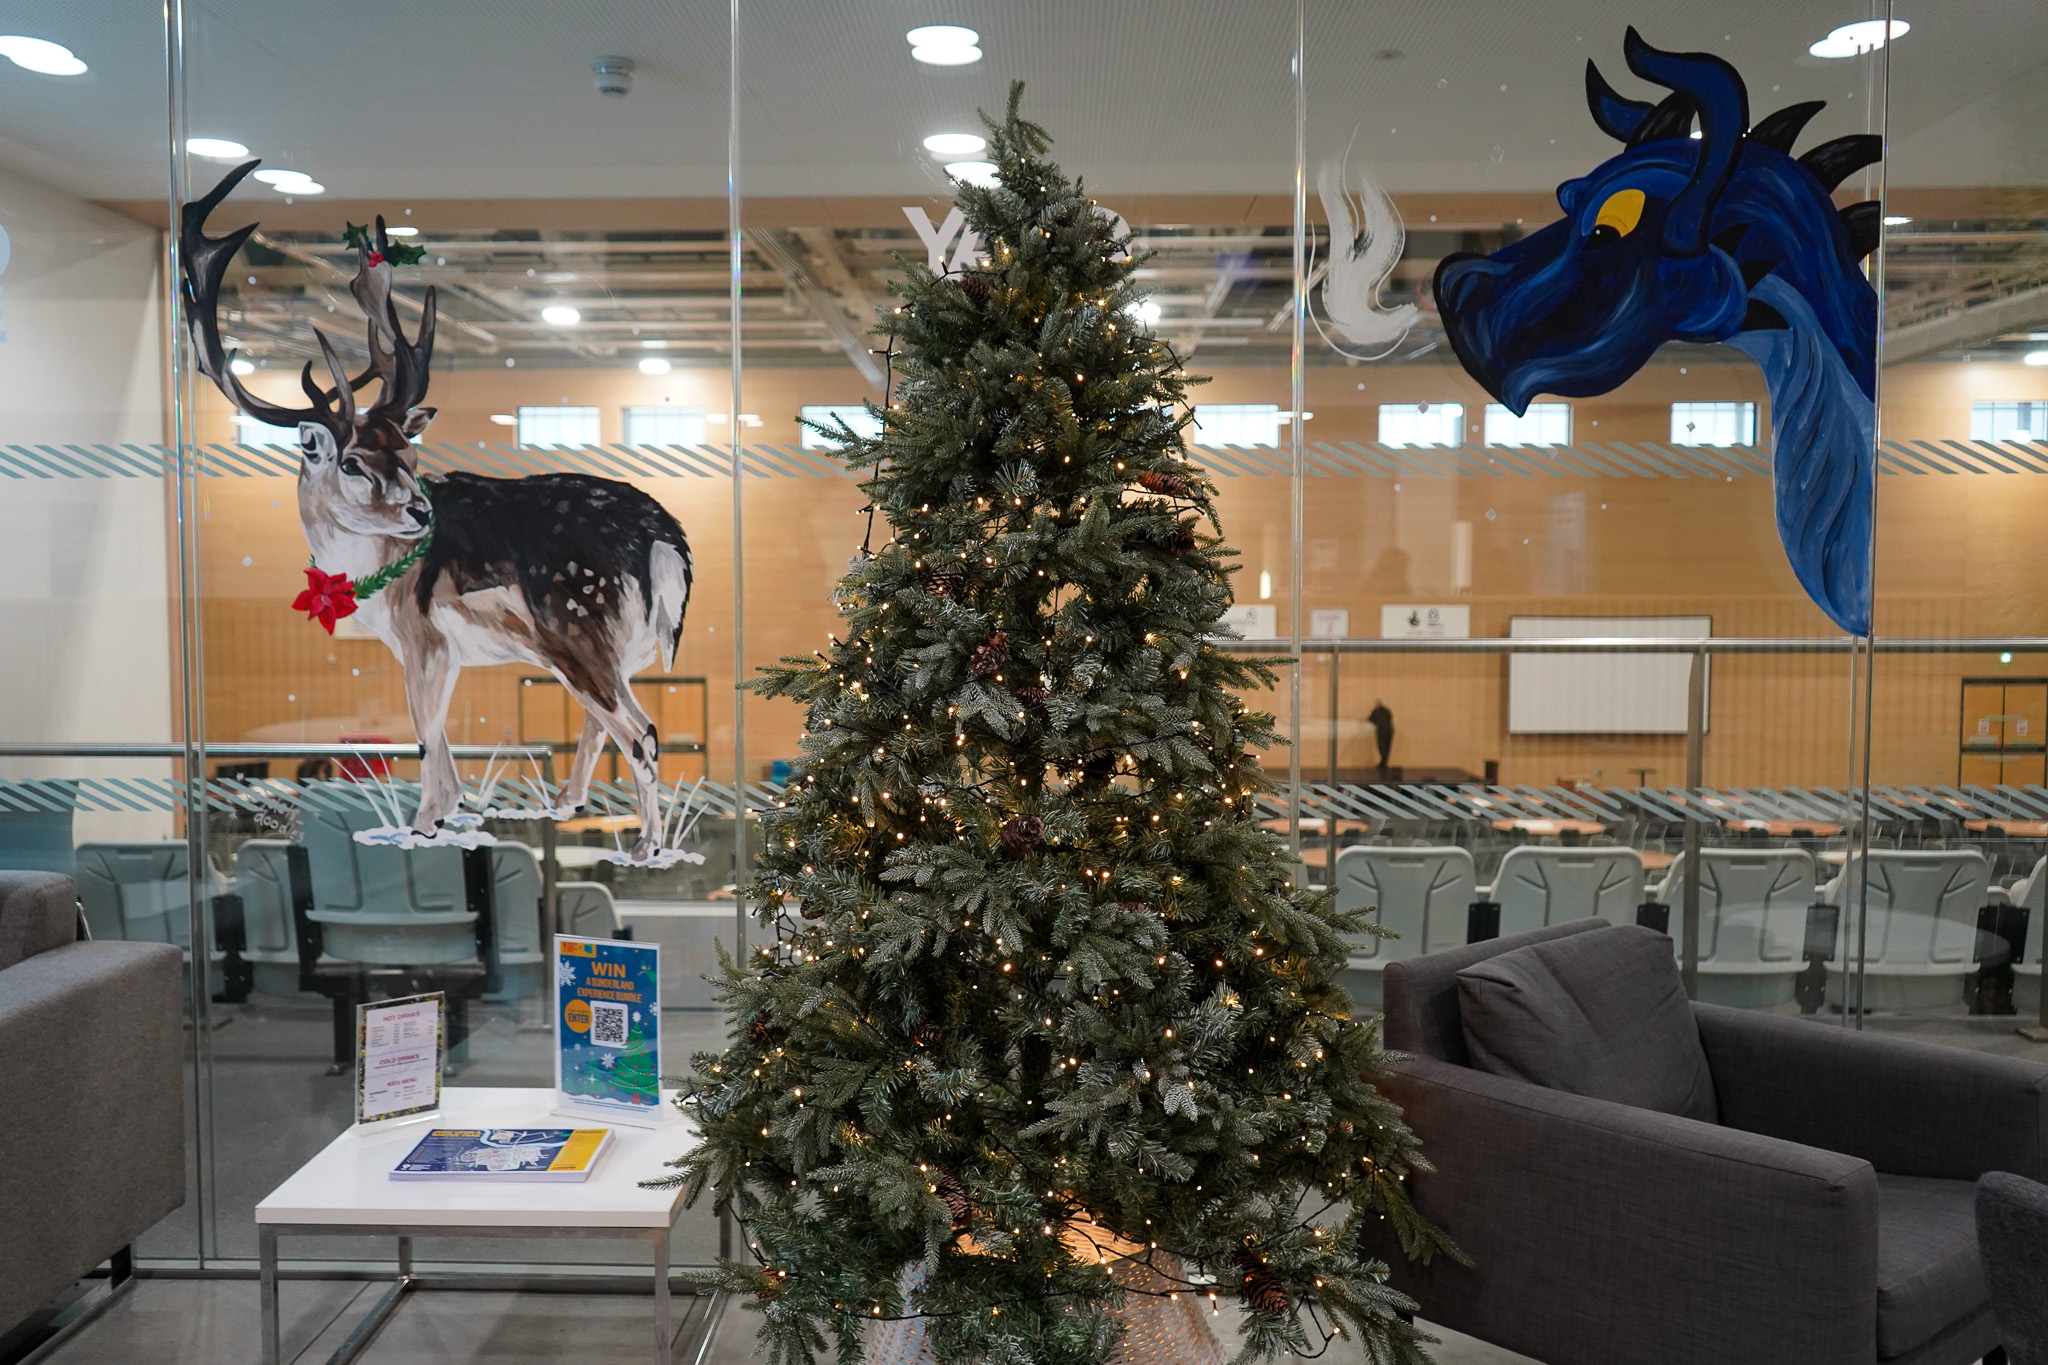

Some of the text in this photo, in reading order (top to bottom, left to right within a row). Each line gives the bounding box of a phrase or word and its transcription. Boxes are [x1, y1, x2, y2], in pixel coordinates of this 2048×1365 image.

[591, 961, 626, 978] WIN
[586, 977, 634, 990] A SUNDERLAND
[577, 987, 642, 1003] EXPERIENCE BUNDLE
[397, 1010, 420, 1020] DRINKS
[568, 1012, 589, 1024] ENTER
[379, 1057, 397, 1065] COLD
[397, 1053, 420, 1062] DRINKS
